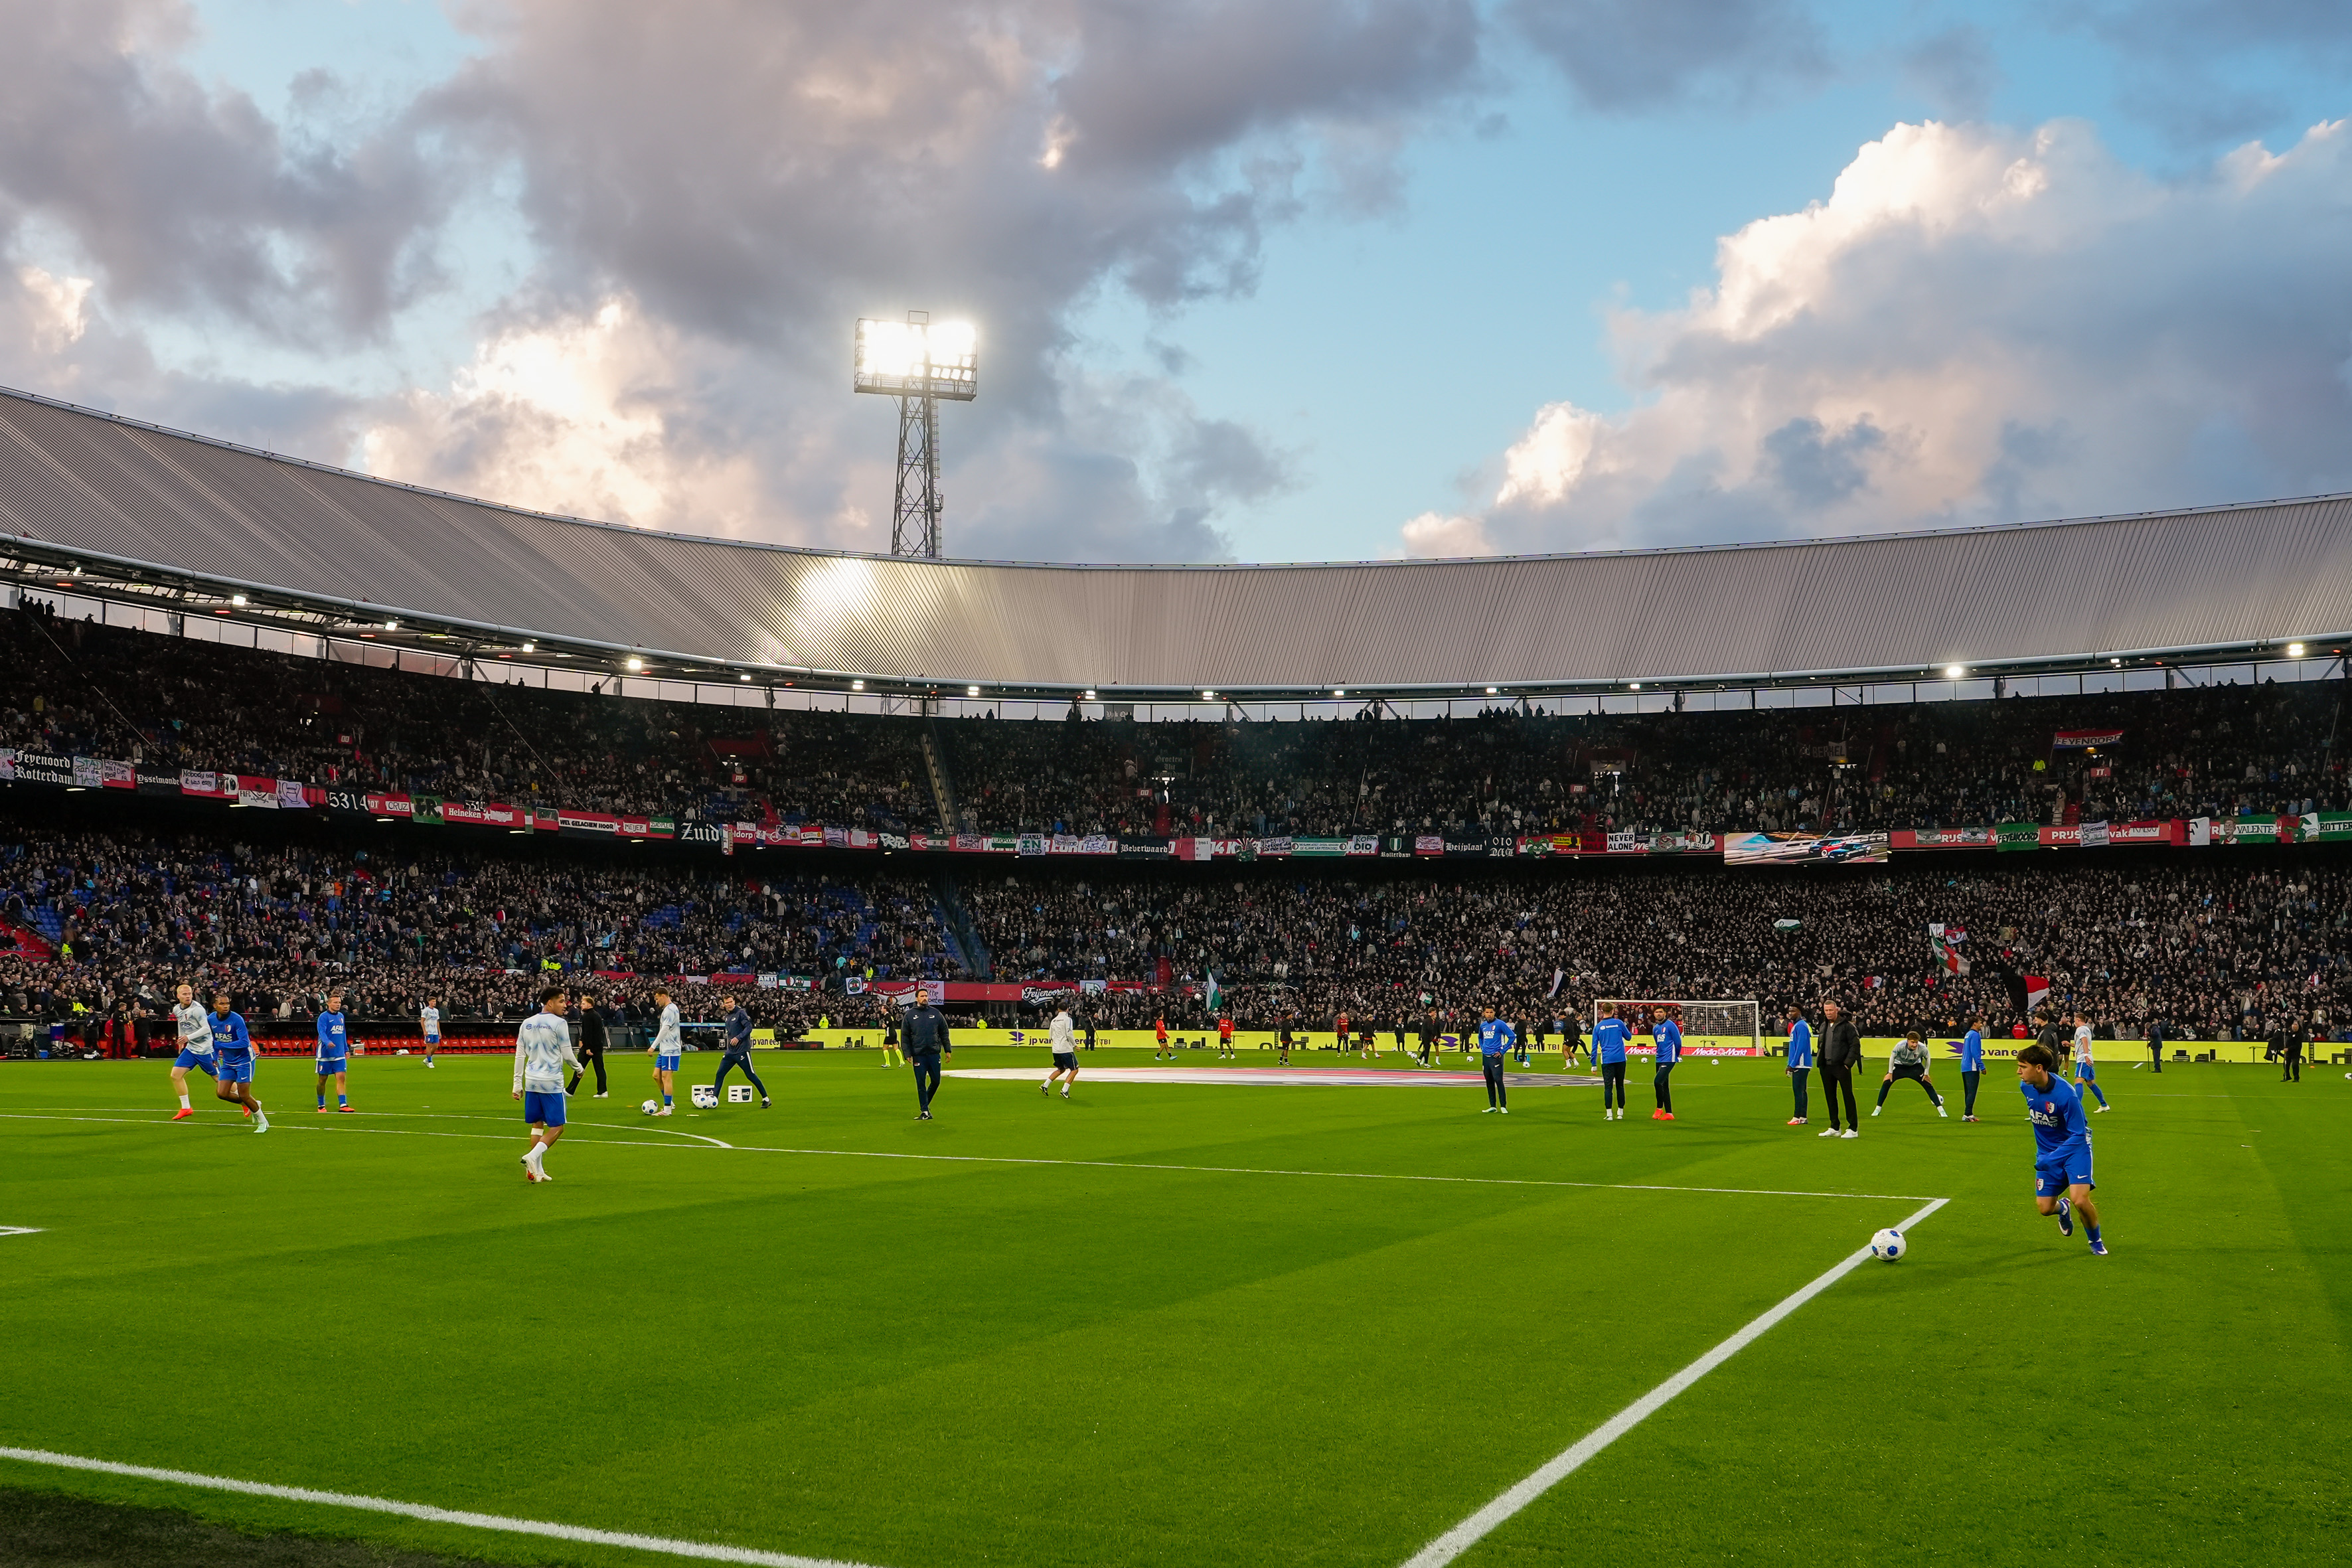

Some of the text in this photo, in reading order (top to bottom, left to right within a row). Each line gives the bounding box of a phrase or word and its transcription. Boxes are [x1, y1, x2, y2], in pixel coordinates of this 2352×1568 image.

[2056, 735, 2122, 744] FEYENOORD
[15, 749, 70, 768] Feyenoord
[74, 757, 102, 769] STAD
[15, 765, 73, 785] Rotterdam
[75, 773, 102, 787] MAAS
[329, 792, 368, 811] 5314
[388, 801, 408, 811] CRUZ
[448, 807, 482, 819] Heineken
[2319, 822, 2352, 830] ROTTER
[680, 823, 720, 842] Zuid
[1998, 832, 2038, 843] FEYENOORD
[1446, 842, 1482, 852] Heijplaat
[1493, 837, 1512, 846] 010
[1029, 1036, 1037, 1046] jp
[2029, 1109, 2058, 1123] AFAS
[2031, 1118, 2058, 1127] software
